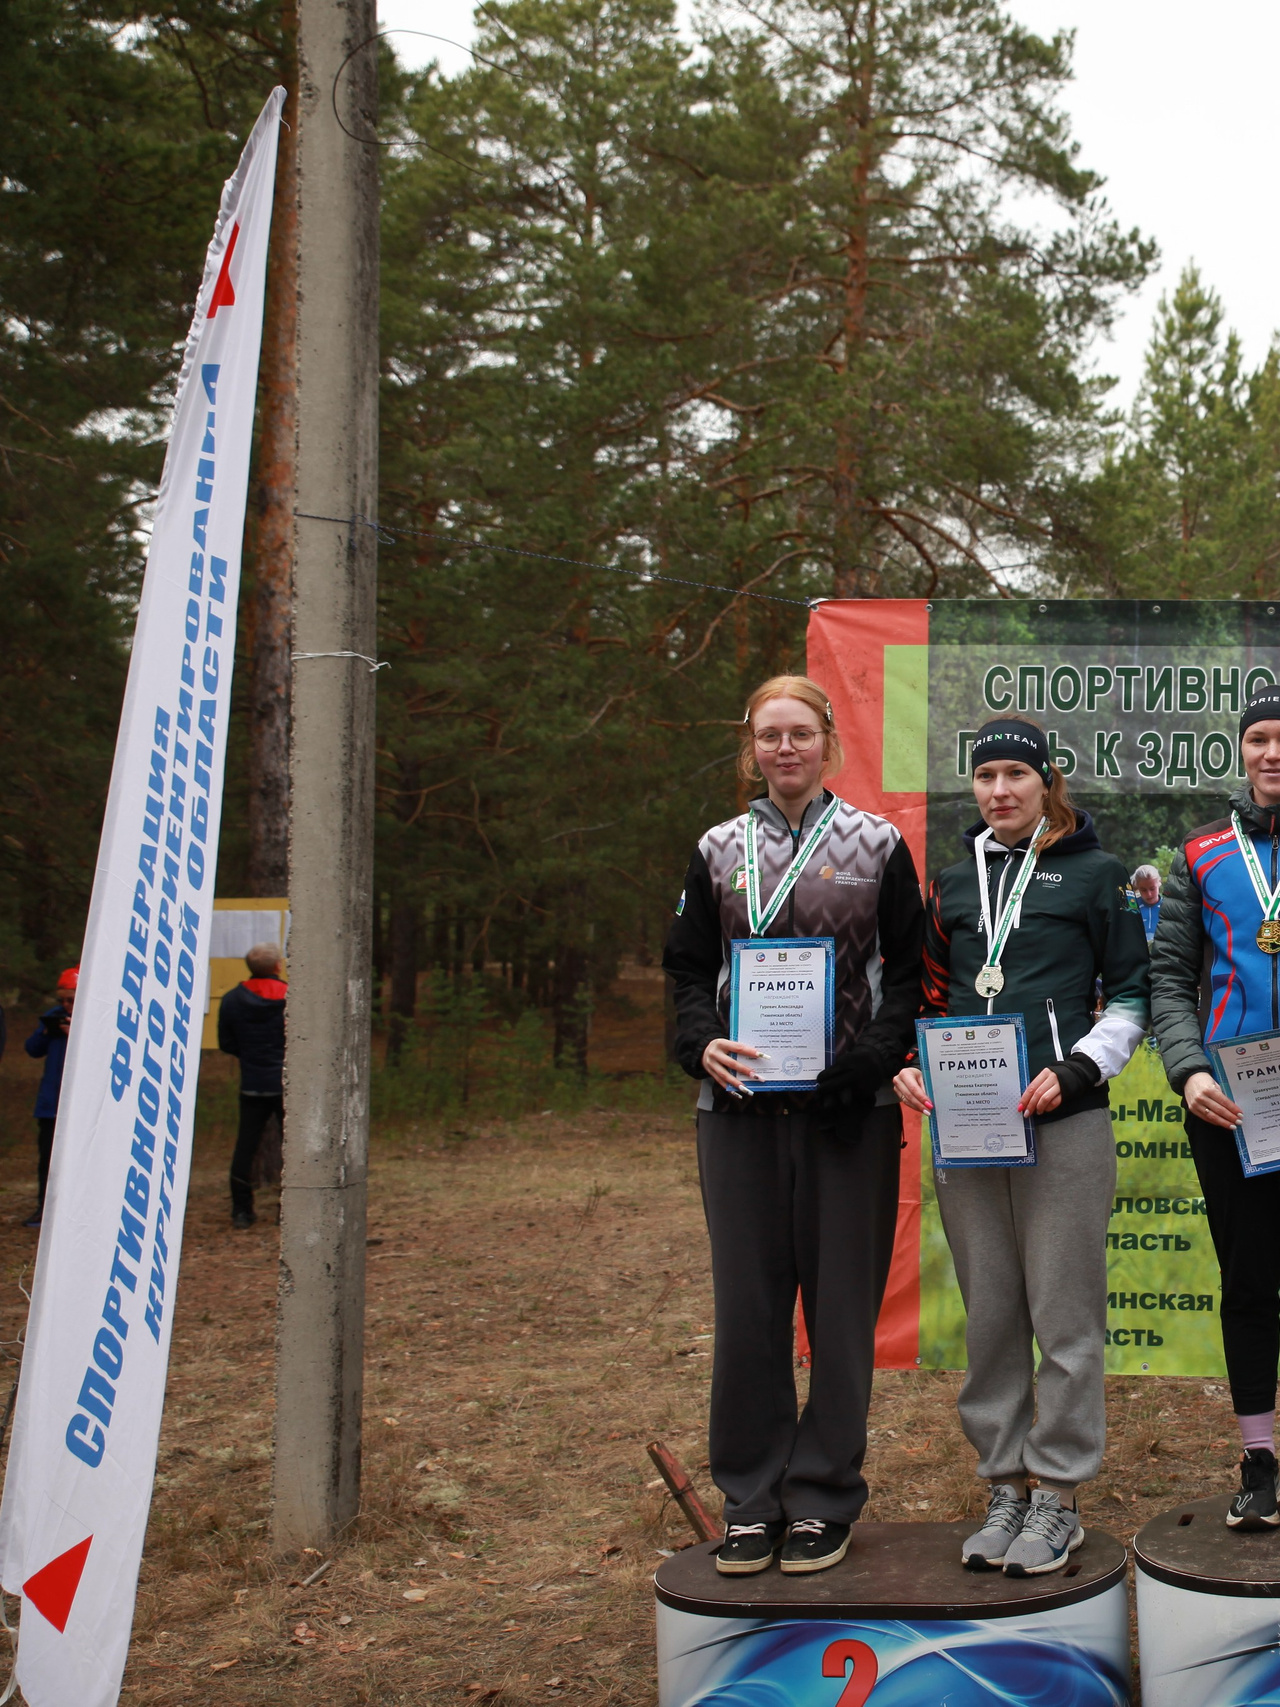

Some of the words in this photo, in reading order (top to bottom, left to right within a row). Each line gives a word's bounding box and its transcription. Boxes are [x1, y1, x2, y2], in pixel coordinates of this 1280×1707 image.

[187, 555, 228, 891] ОБЛАСТИ
[1095, 731, 1123, 778] К
[110, 705, 171, 1102] ФЕДЕРАЦИЯ
[749, 980, 815, 992] ГРАМОТА
[939, 1058, 1008, 1071] ГРАМОТА
[66, 998, 166, 1468] СПОРТИВНОГО
[1105, 1232, 1192, 1252] ласть
[822, 1638, 879, 1707] 2
